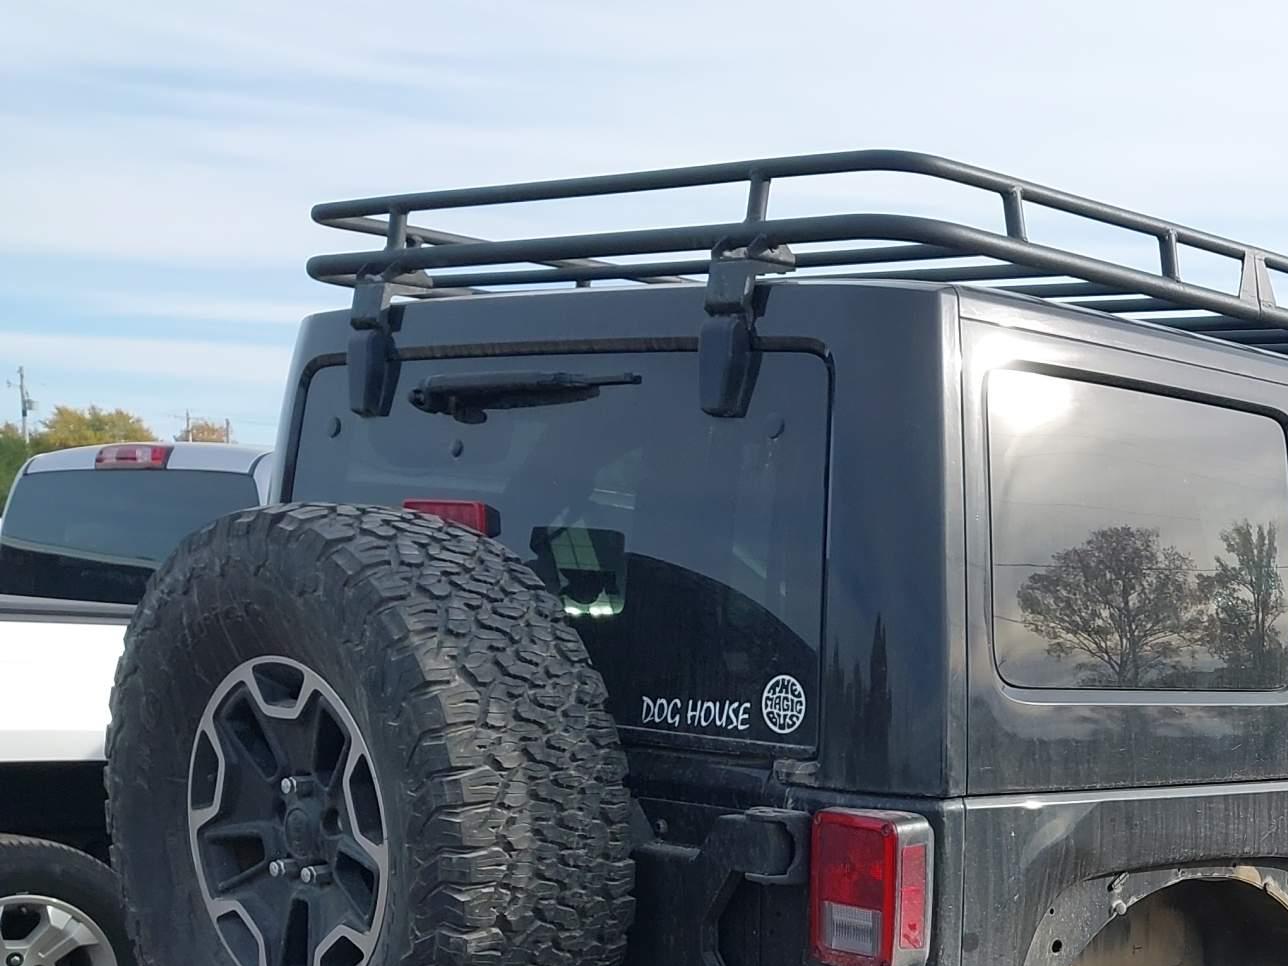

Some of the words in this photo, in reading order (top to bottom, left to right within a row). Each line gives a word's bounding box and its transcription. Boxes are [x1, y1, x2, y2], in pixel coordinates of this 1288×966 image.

[767, 678, 803, 699] THE
[641, 695, 681, 727] DOG
[686, 700, 751, 730] HOUSE
[764, 694, 804, 714] MAGIC
[766, 710, 801, 731] BUS
